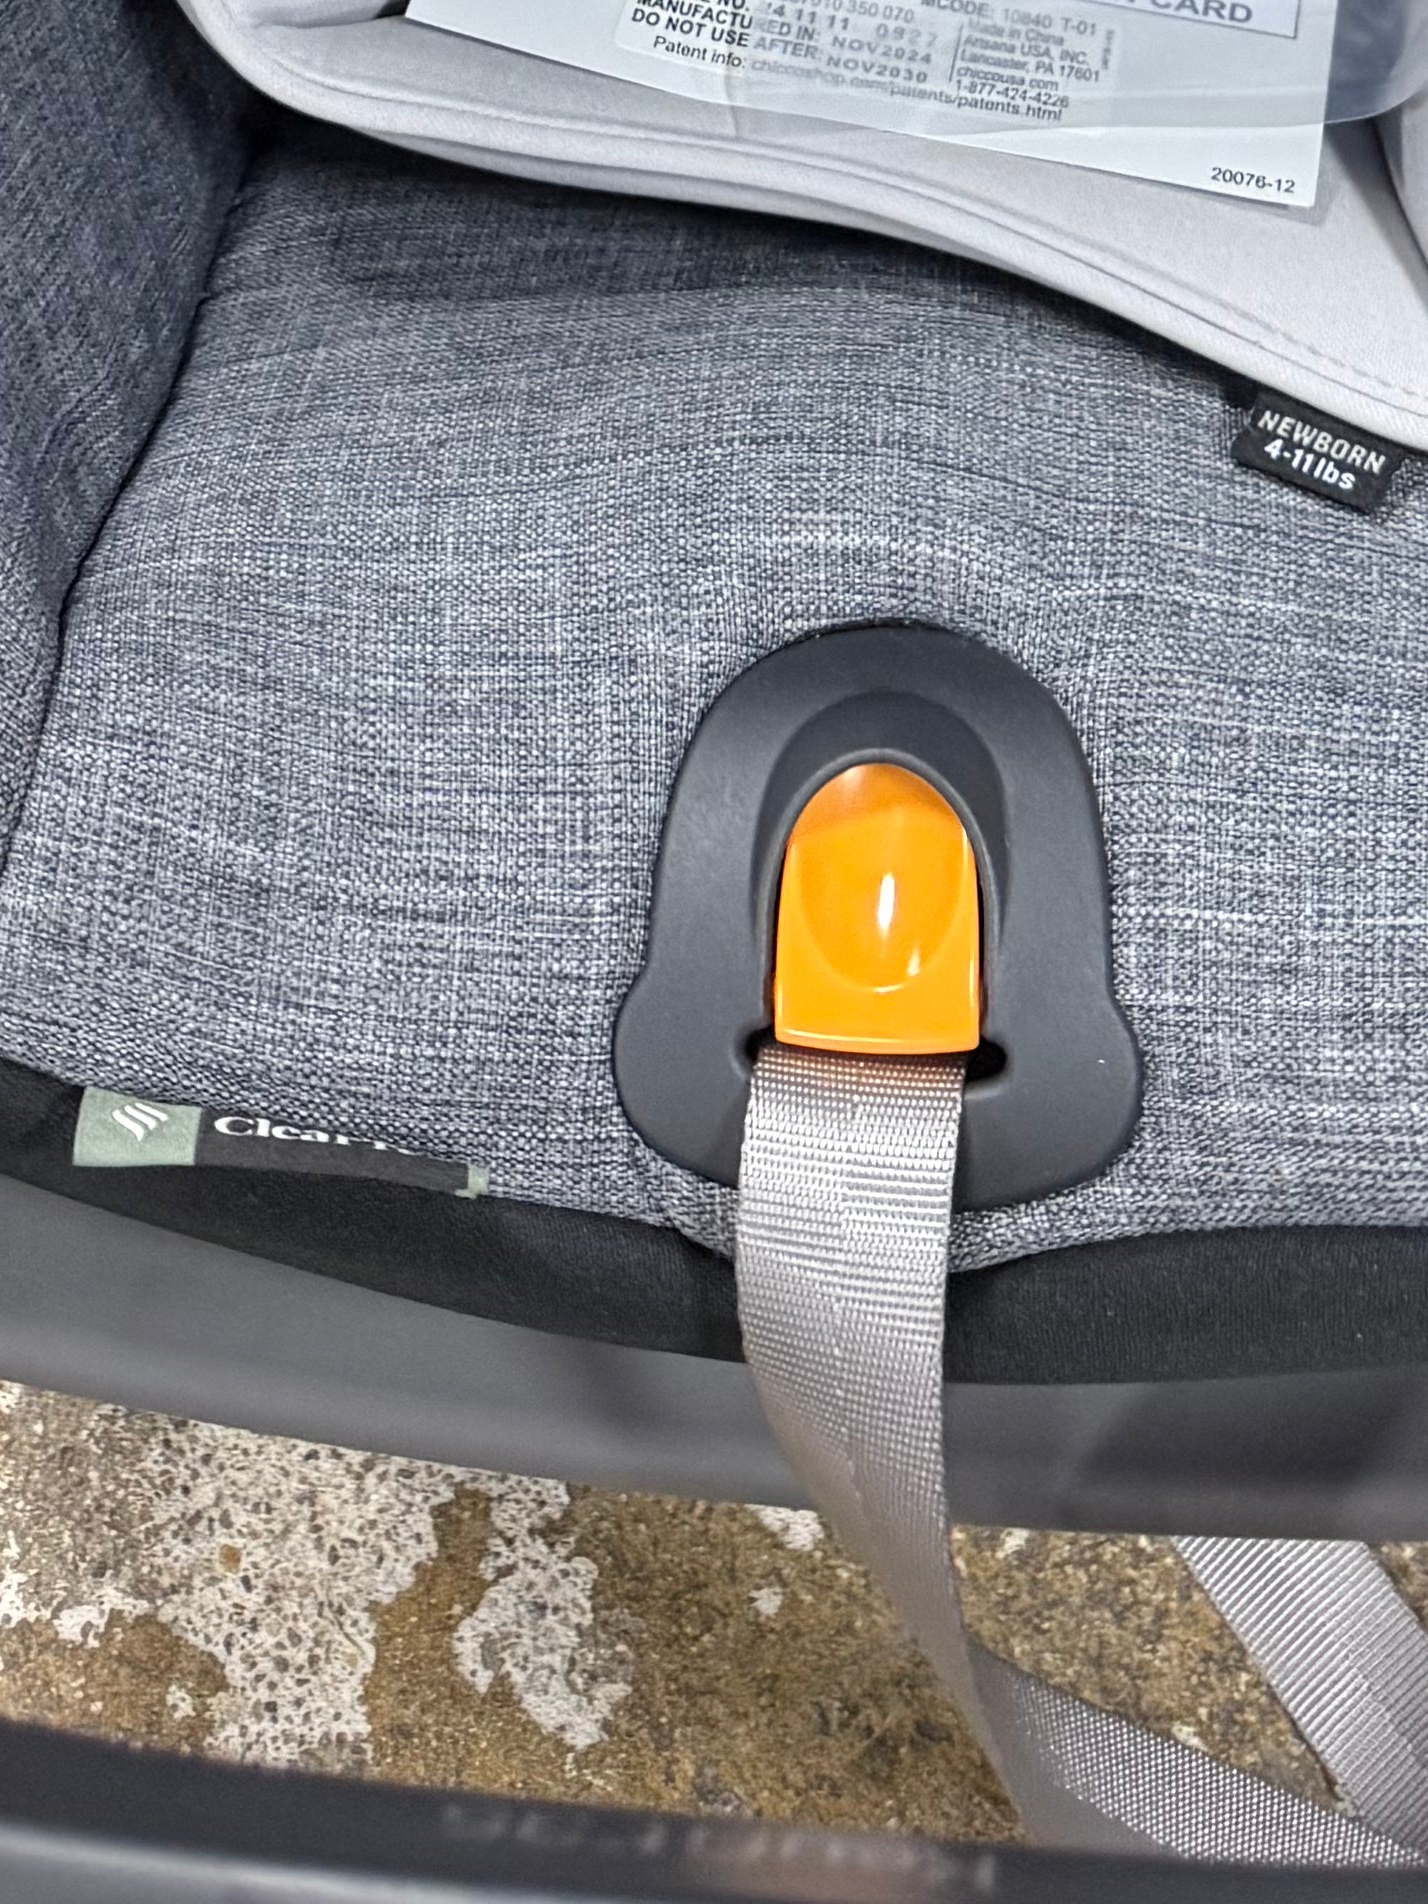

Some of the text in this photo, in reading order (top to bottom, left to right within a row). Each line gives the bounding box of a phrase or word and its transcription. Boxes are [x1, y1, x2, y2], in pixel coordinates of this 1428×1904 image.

[631, 8, 660, 26] DO
[665, 17, 707, 38] NOT
[711, 26, 751, 48] USE
[653, 35, 707, 62] Patent
[711, 49, 746, 69] info:
[1035, 61, 1054, 76] PA
[1257, 410, 1387, 475] NEWBORN
